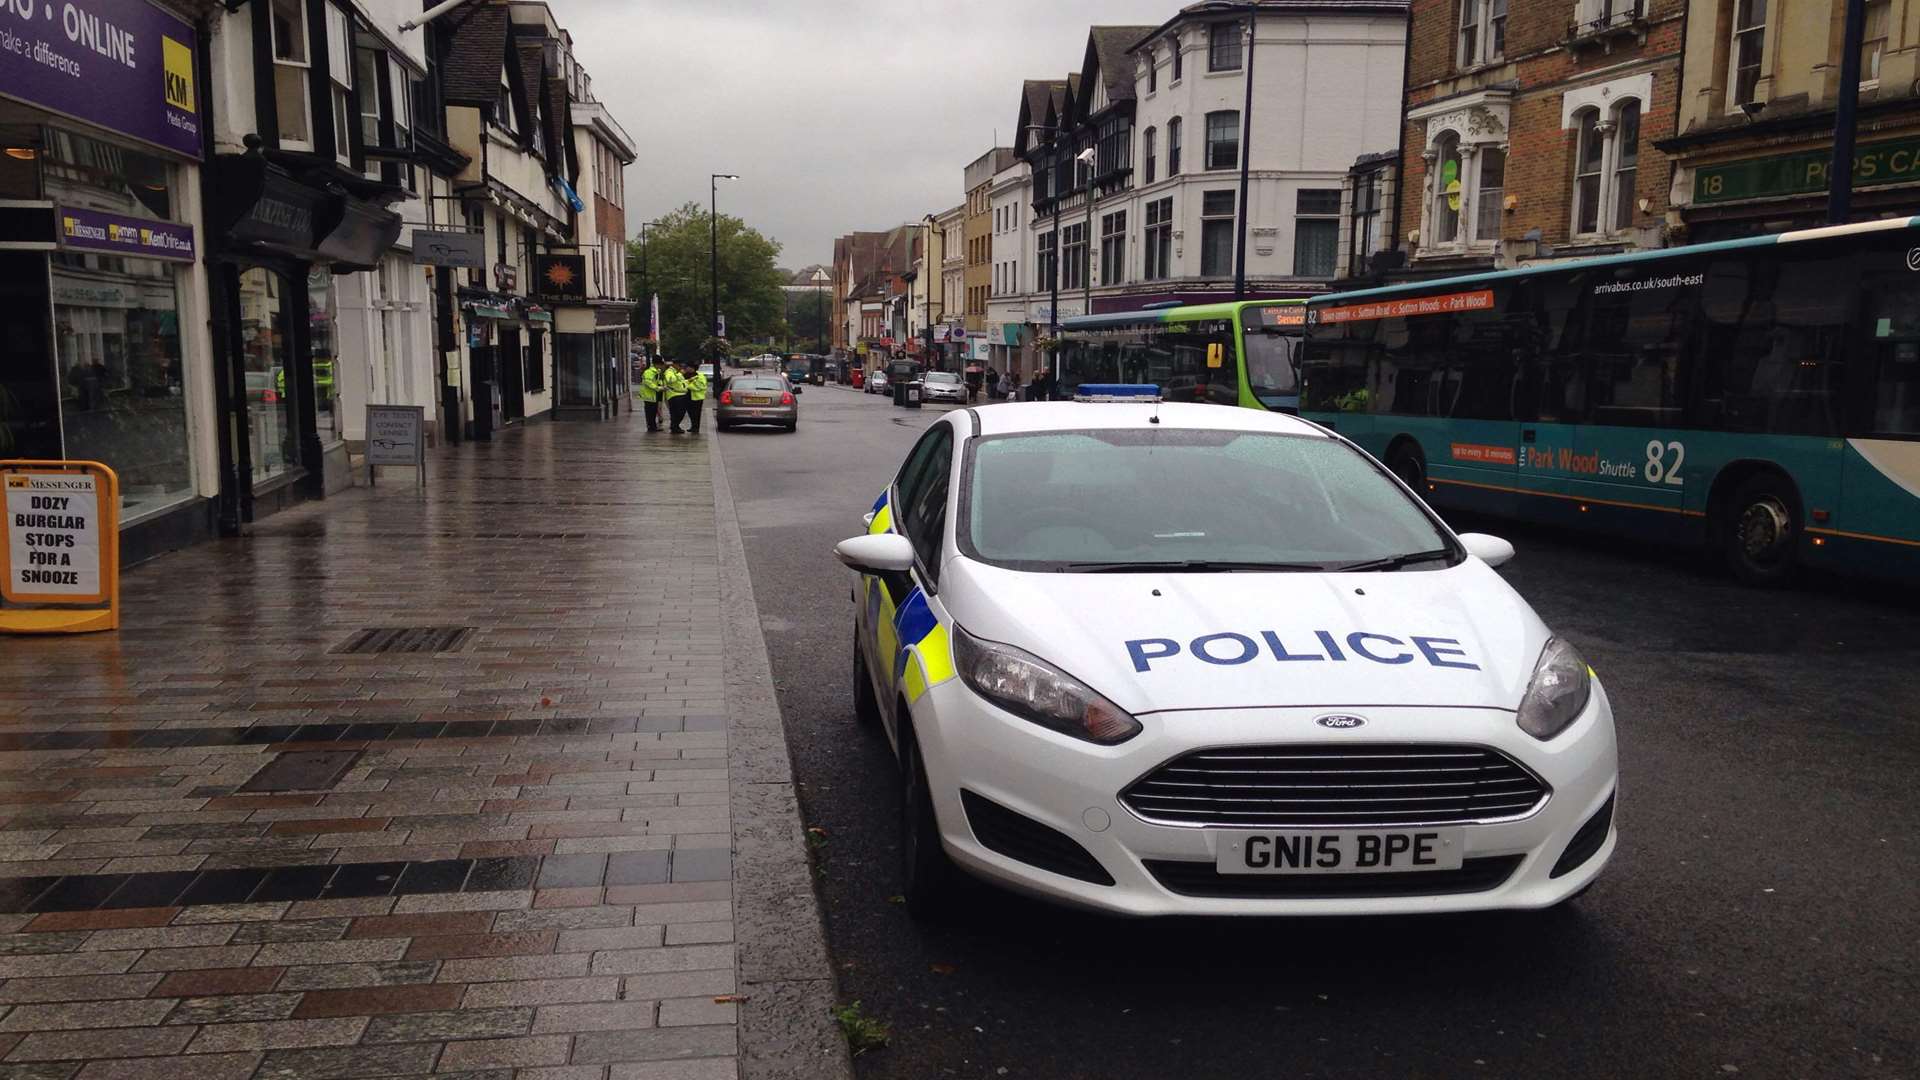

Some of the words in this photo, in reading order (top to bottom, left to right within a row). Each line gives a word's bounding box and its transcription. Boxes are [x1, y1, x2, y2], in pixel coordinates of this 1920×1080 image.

[63, 3, 136, 68] ONLINE
[25, 41, 32, 58] a
[34, 40, 80, 77] difference
[165, 70, 187, 106] KM
[1806, 152, 1884, 184] PS'
[1703, 175, 1723, 195] 18
[1594, 273, 1704, 295] arrivabus.co.uk/south-east
[1308, 310, 1318, 324] 82
[1518, 446, 1526, 468] the
[1528, 446, 1553, 469] Park
[1559, 447, 1598, 474] Wood
[1599, 459, 1637, 479] Shuttle
[1644, 439, 1685, 486] 82
[30, 481, 92, 490] MESSENGER
[31, 496, 69, 510] DOZY
[15, 514, 85, 530] BURGLAR
[25, 532, 75, 548] STOPS
[29, 551, 57, 566] FOR
[60, 553, 71, 566] A
[21, 569, 78, 585] SNOOZE
[1124, 630, 1482, 673] POLICE
[1325, 715, 1357, 728] Ford
[1244, 834, 1341, 869] GN15
[1355, 833, 1438, 868] BPE
